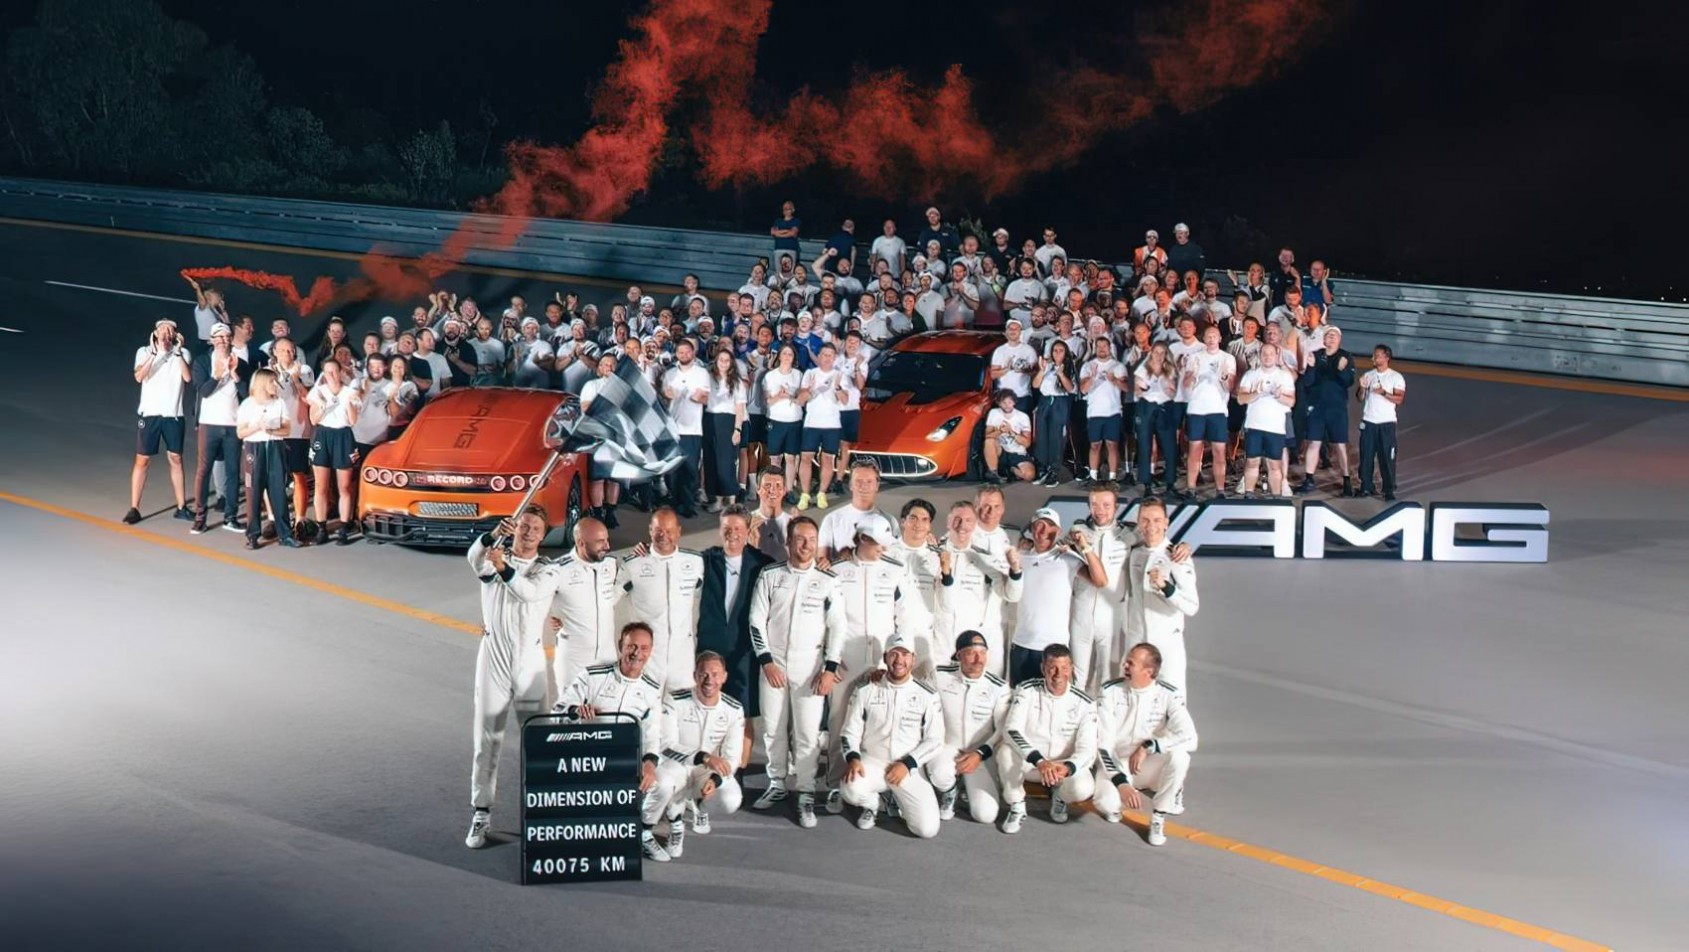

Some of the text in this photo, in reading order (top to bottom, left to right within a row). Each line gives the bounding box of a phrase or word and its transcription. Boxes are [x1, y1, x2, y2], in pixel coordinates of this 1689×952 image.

[427, 475, 474, 484] RECORD
[1178, 503, 1550, 563] AMG
[569, 730, 613, 741] AMG
[557, 757, 606, 773] A NEW
[527, 789, 636, 807] DIMENSION OF
[527, 823, 636, 841] PERFORMANCE
[533, 856, 625, 874] 40075 KM
